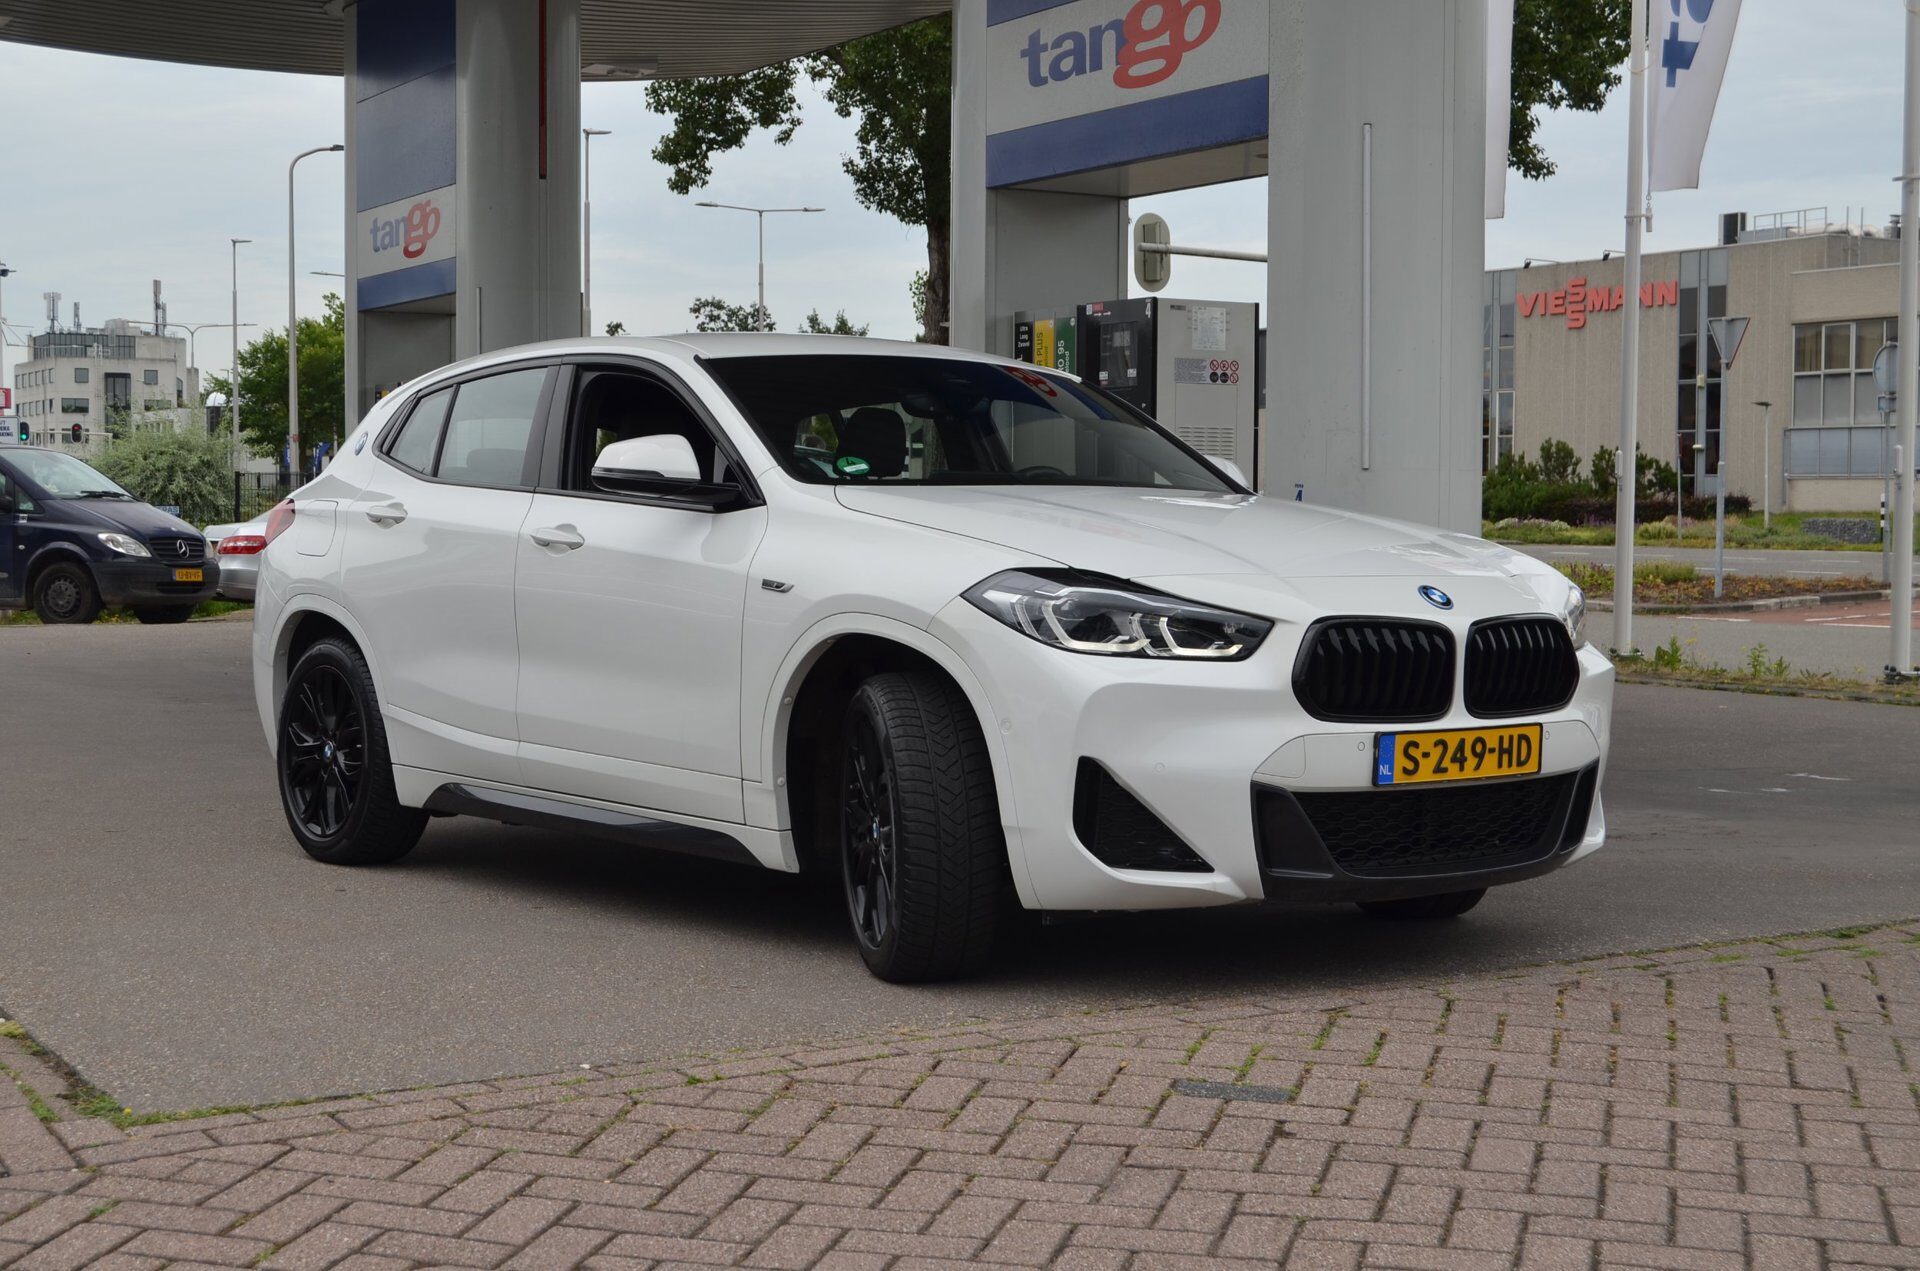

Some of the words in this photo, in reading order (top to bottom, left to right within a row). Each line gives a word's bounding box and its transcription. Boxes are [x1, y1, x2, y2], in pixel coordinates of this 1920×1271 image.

[1020, 0, 1221, 88] tango
[369, 199, 441, 259] tango
[1516, 276, 1678, 330] VIESSMANN
[1058, 340, 1064, 354] 95
[1379, 764, 1392, 775] NL
[1401, 733, 1532, 776] S-249-HD
